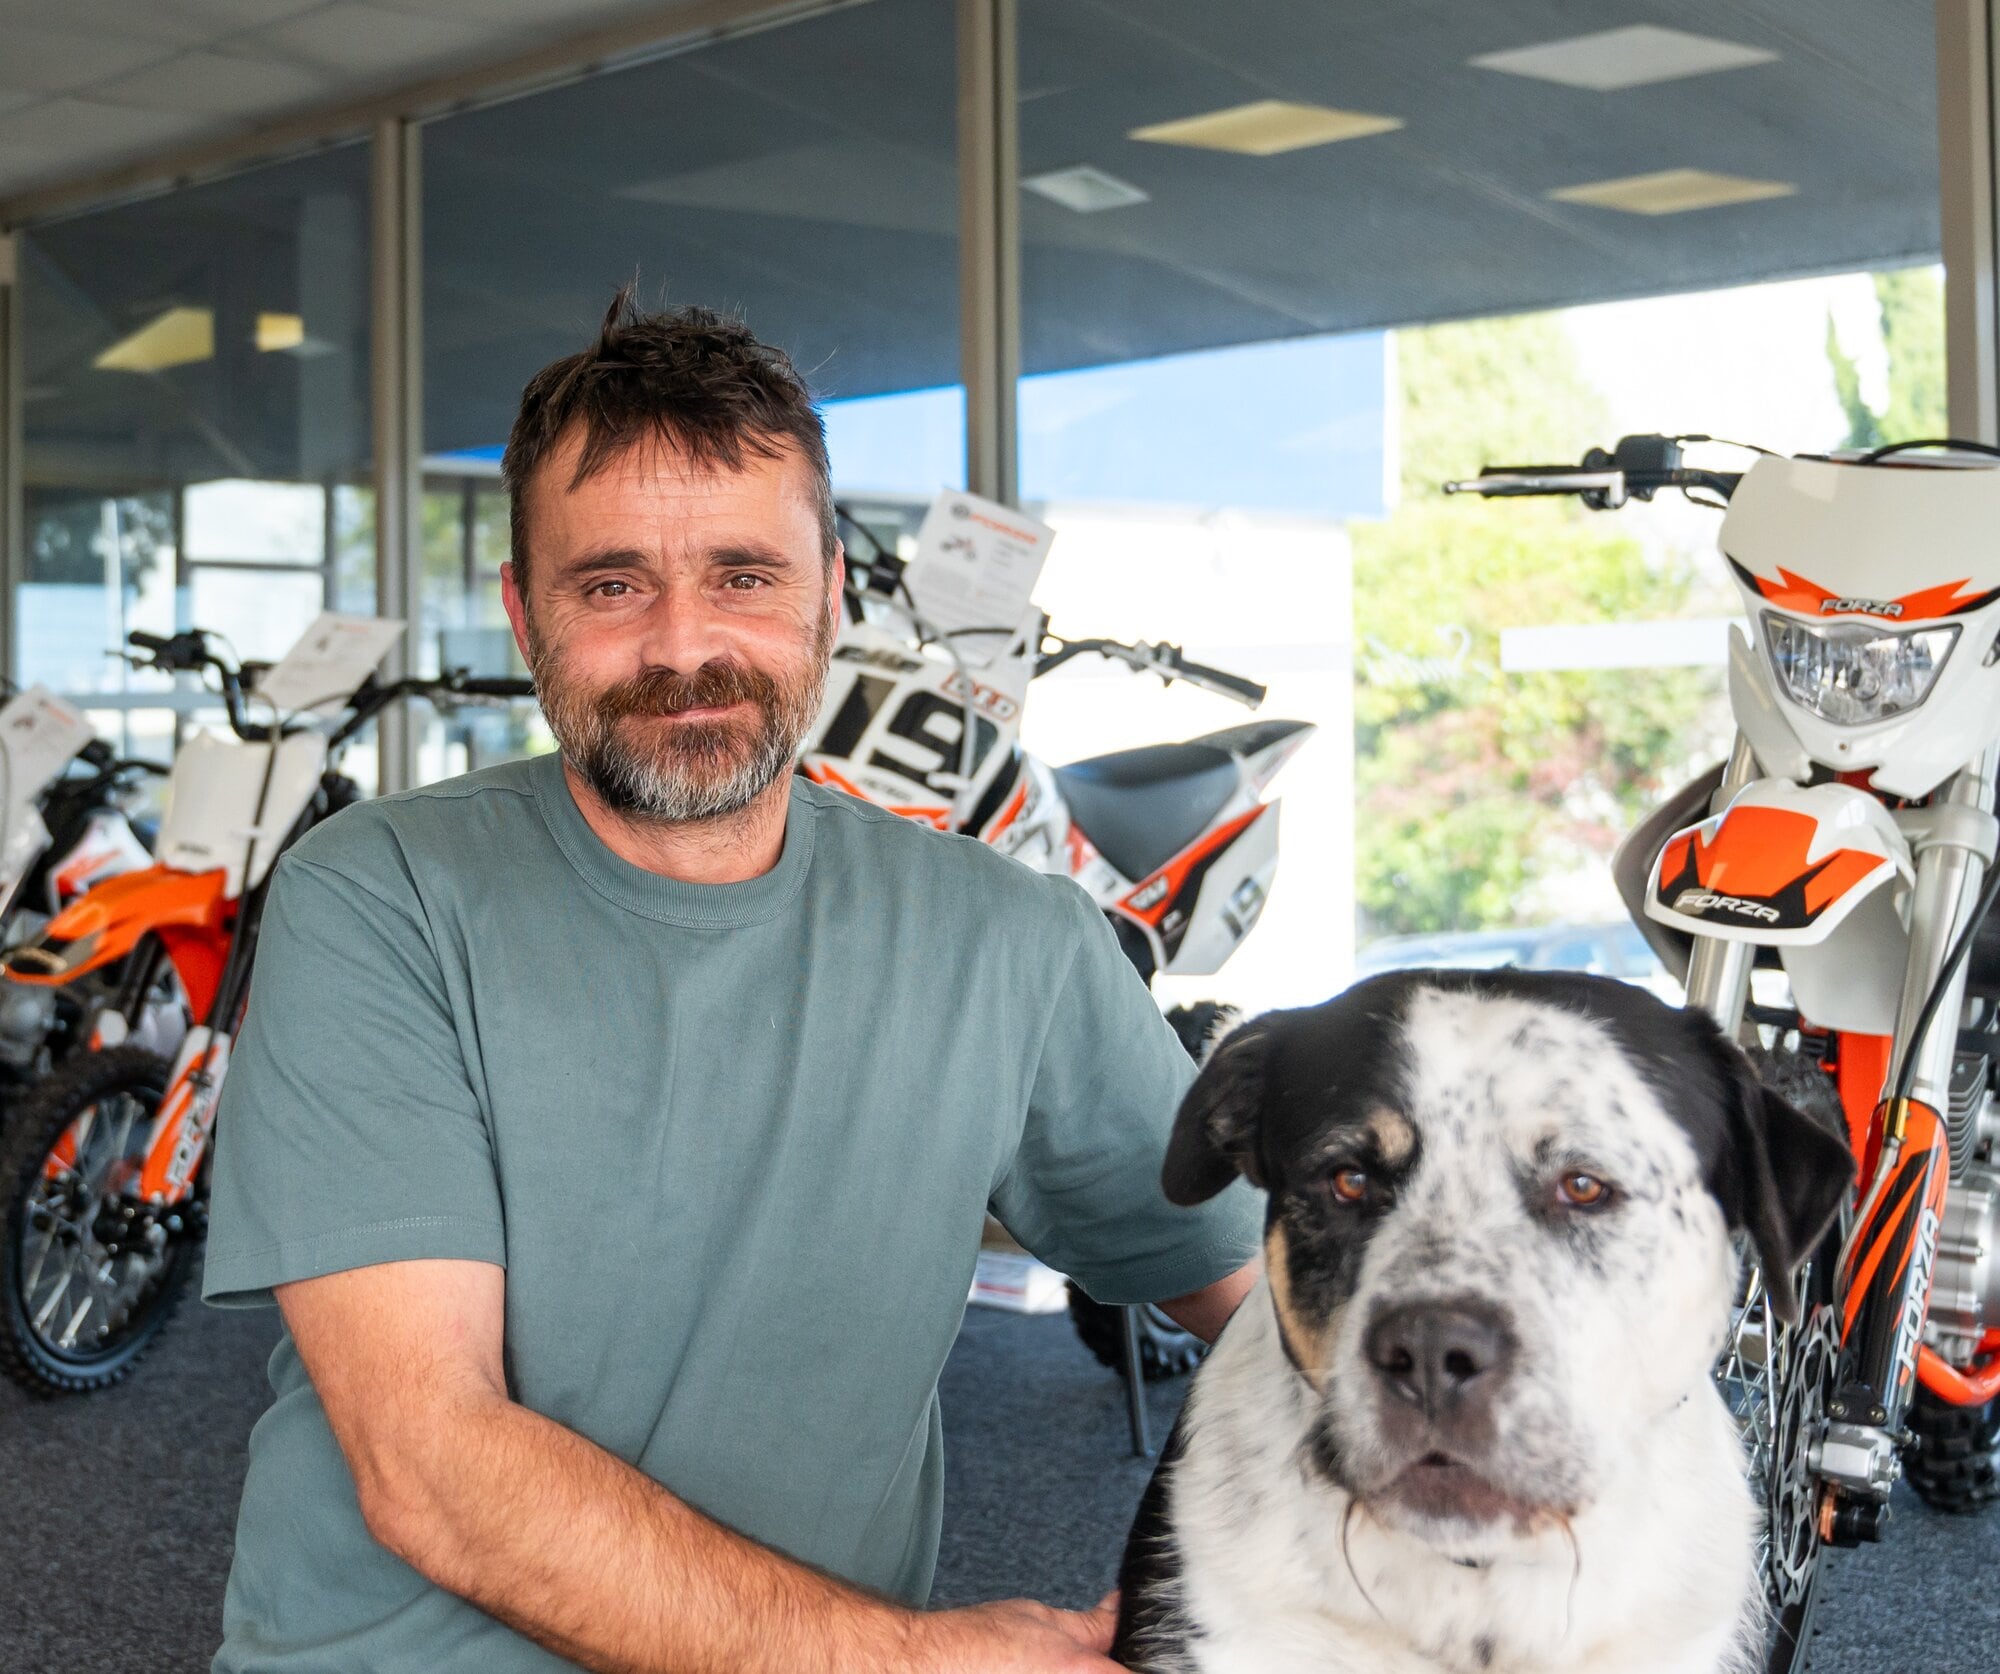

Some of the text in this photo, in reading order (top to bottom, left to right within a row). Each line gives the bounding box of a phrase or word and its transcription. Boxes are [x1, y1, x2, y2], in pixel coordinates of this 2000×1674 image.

[1819, 598, 1904, 618] FORZA
[818, 672, 999, 800] 19
[1676, 894, 1780, 923] FORZA
[1896, 1206, 1940, 1373] FORZA
